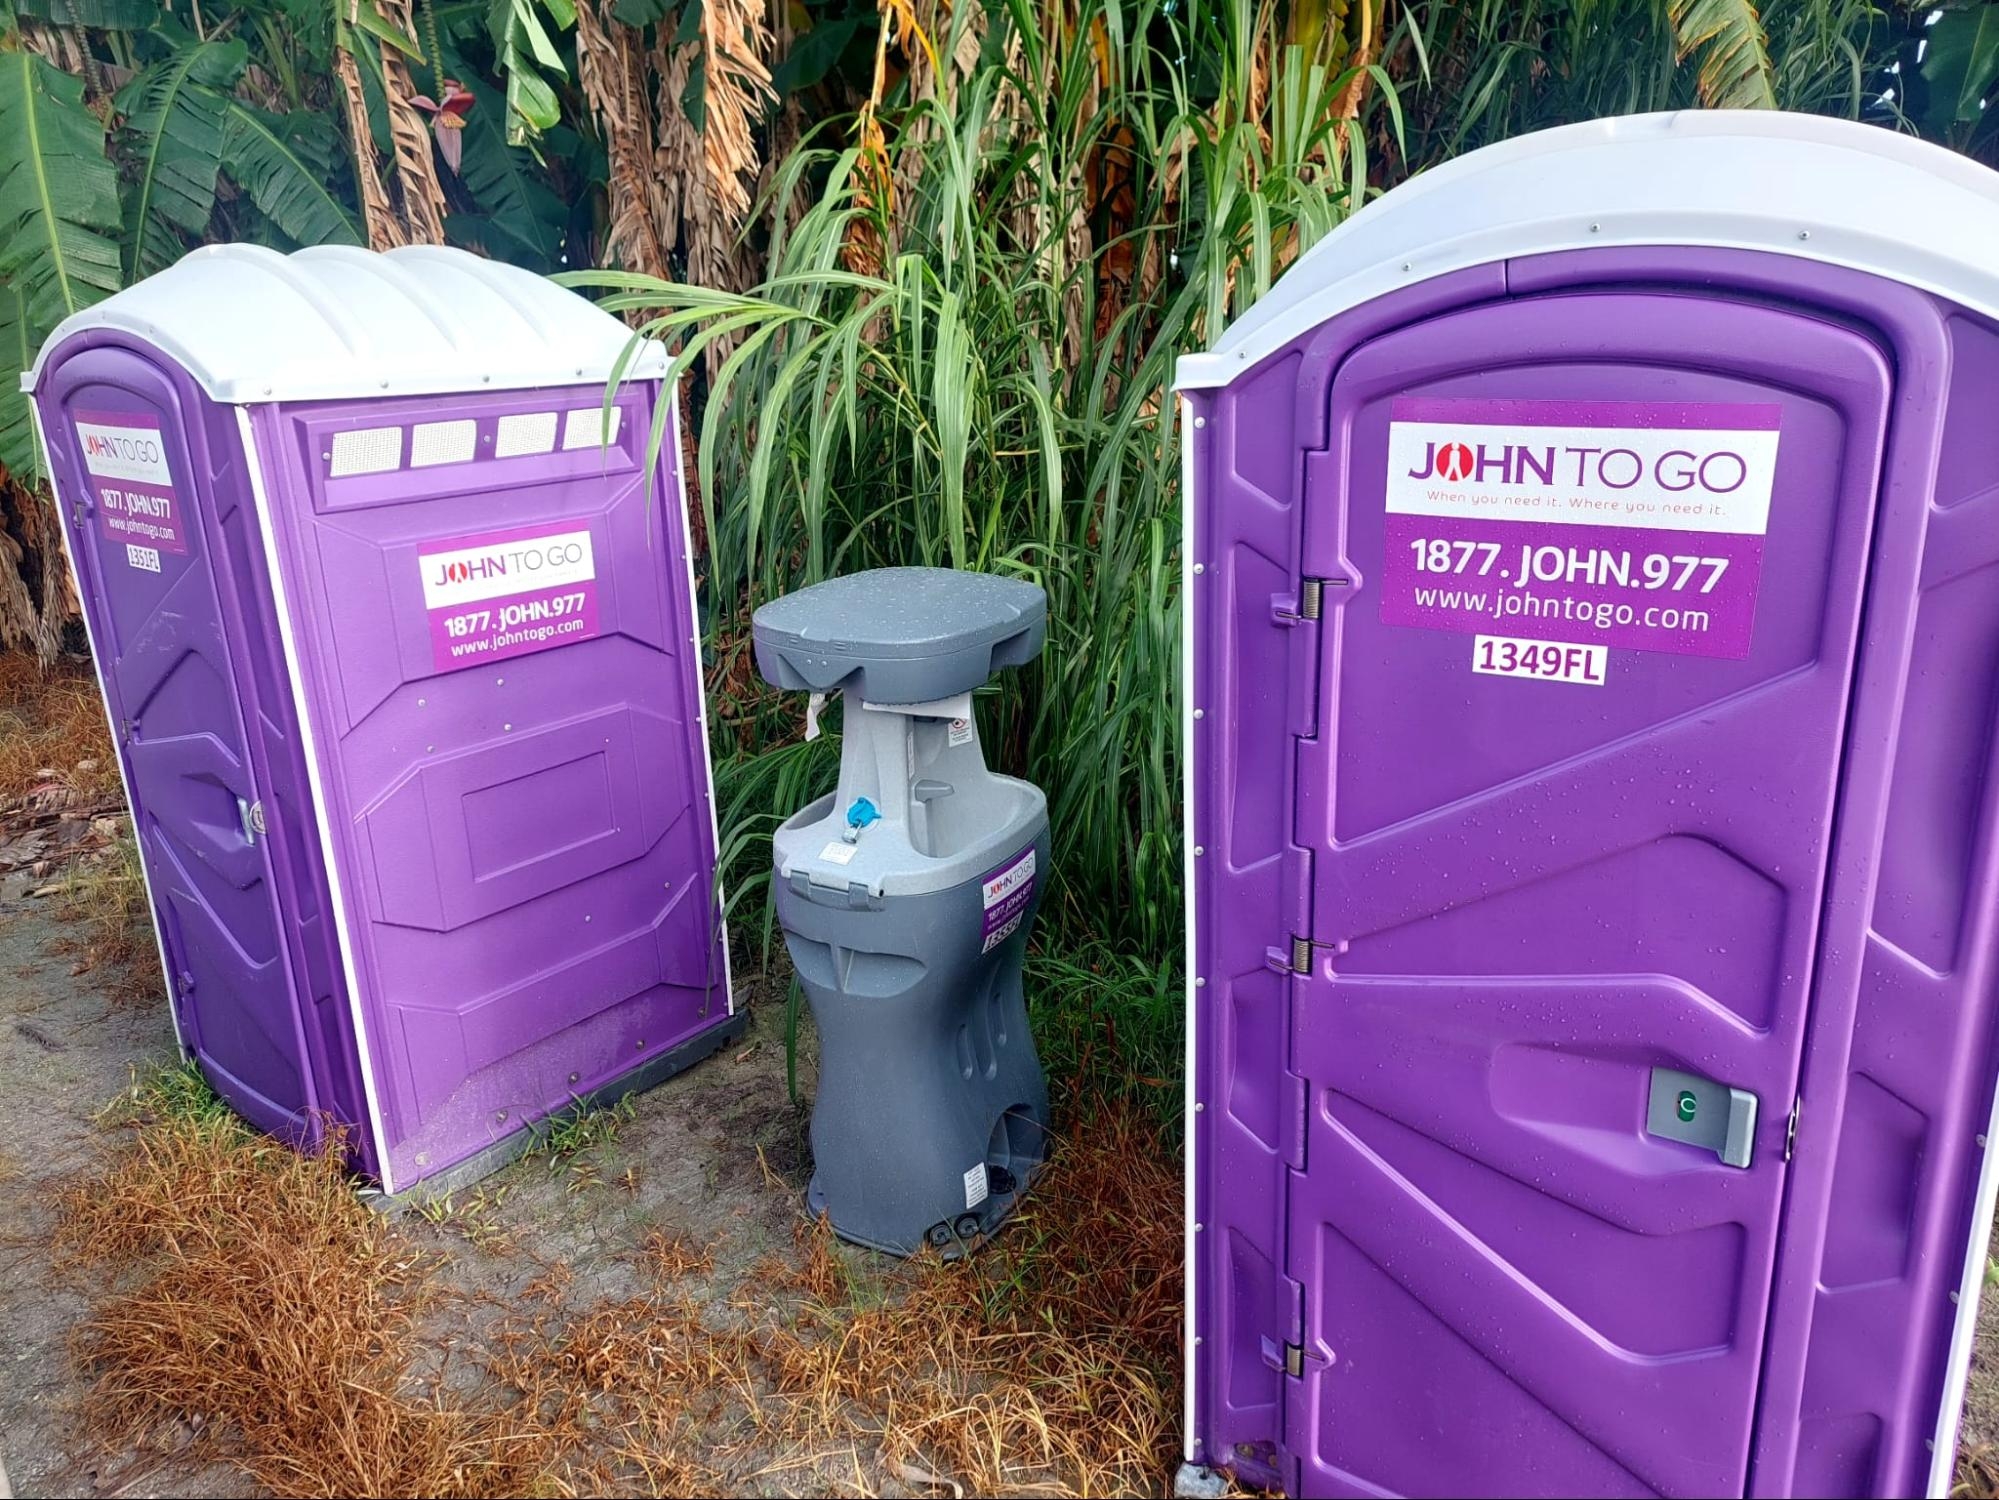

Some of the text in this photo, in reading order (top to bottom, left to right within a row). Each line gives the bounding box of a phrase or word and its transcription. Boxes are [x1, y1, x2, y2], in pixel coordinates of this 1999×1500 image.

[86, 434, 118, 458] JOHN
[1408, 442, 1747, 493] JOHN TO GO
[1427, 490, 1727, 516] When you need it. Where you need it.
[108, 517, 176, 541] www.johntogo.com
[435, 554, 507, 586] JOHN
[508, 549, 543, 573] TO
[547, 543, 583, 567] GO
[1414, 586, 1710, 632] www.johntogo.com
[451, 619, 584, 657] www.johntogo.com
[1480, 640, 1600, 682] 1349FL
[988, 874, 1013, 899] JOHN
